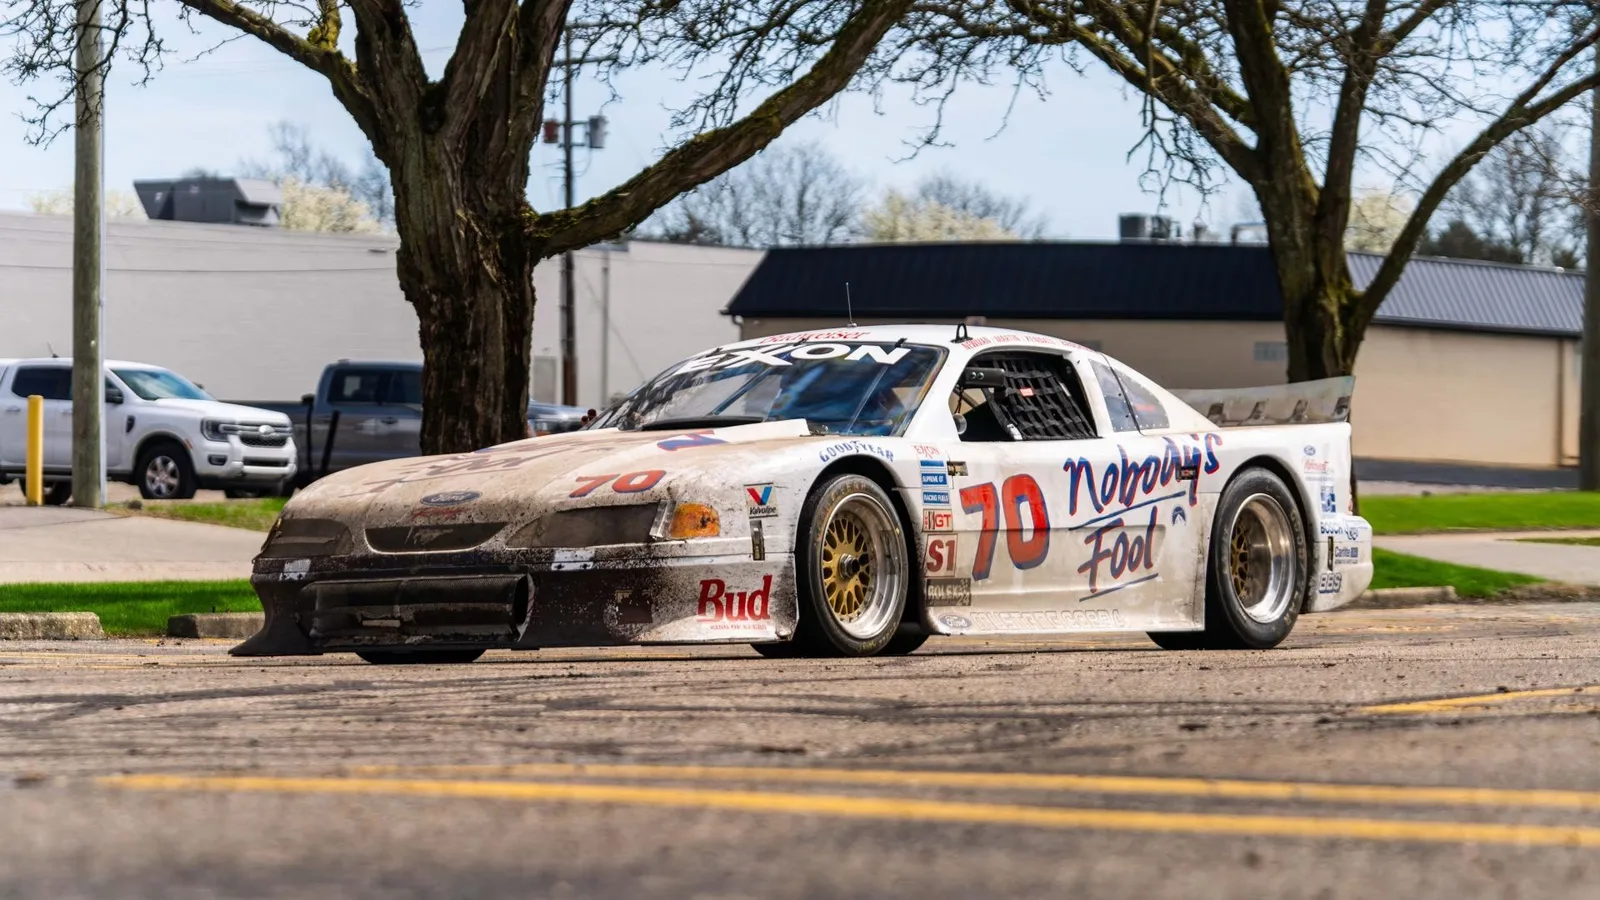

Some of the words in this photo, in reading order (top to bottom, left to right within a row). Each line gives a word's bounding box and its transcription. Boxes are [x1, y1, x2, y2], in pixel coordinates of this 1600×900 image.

[820, 440, 894, 462] GOODYEAR
[569, 469, 667, 498] 70
[922, 475, 939, 483] SUPREME
[749, 506, 776, 515] Valvoline
[935, 513, 951, 528] GT
[959, 473, 1050, 581] 70
[926, 539, 956, 572] S1
[1319, 572, 1342, 594] BBS
[697, 575, 773, 622] Bud
